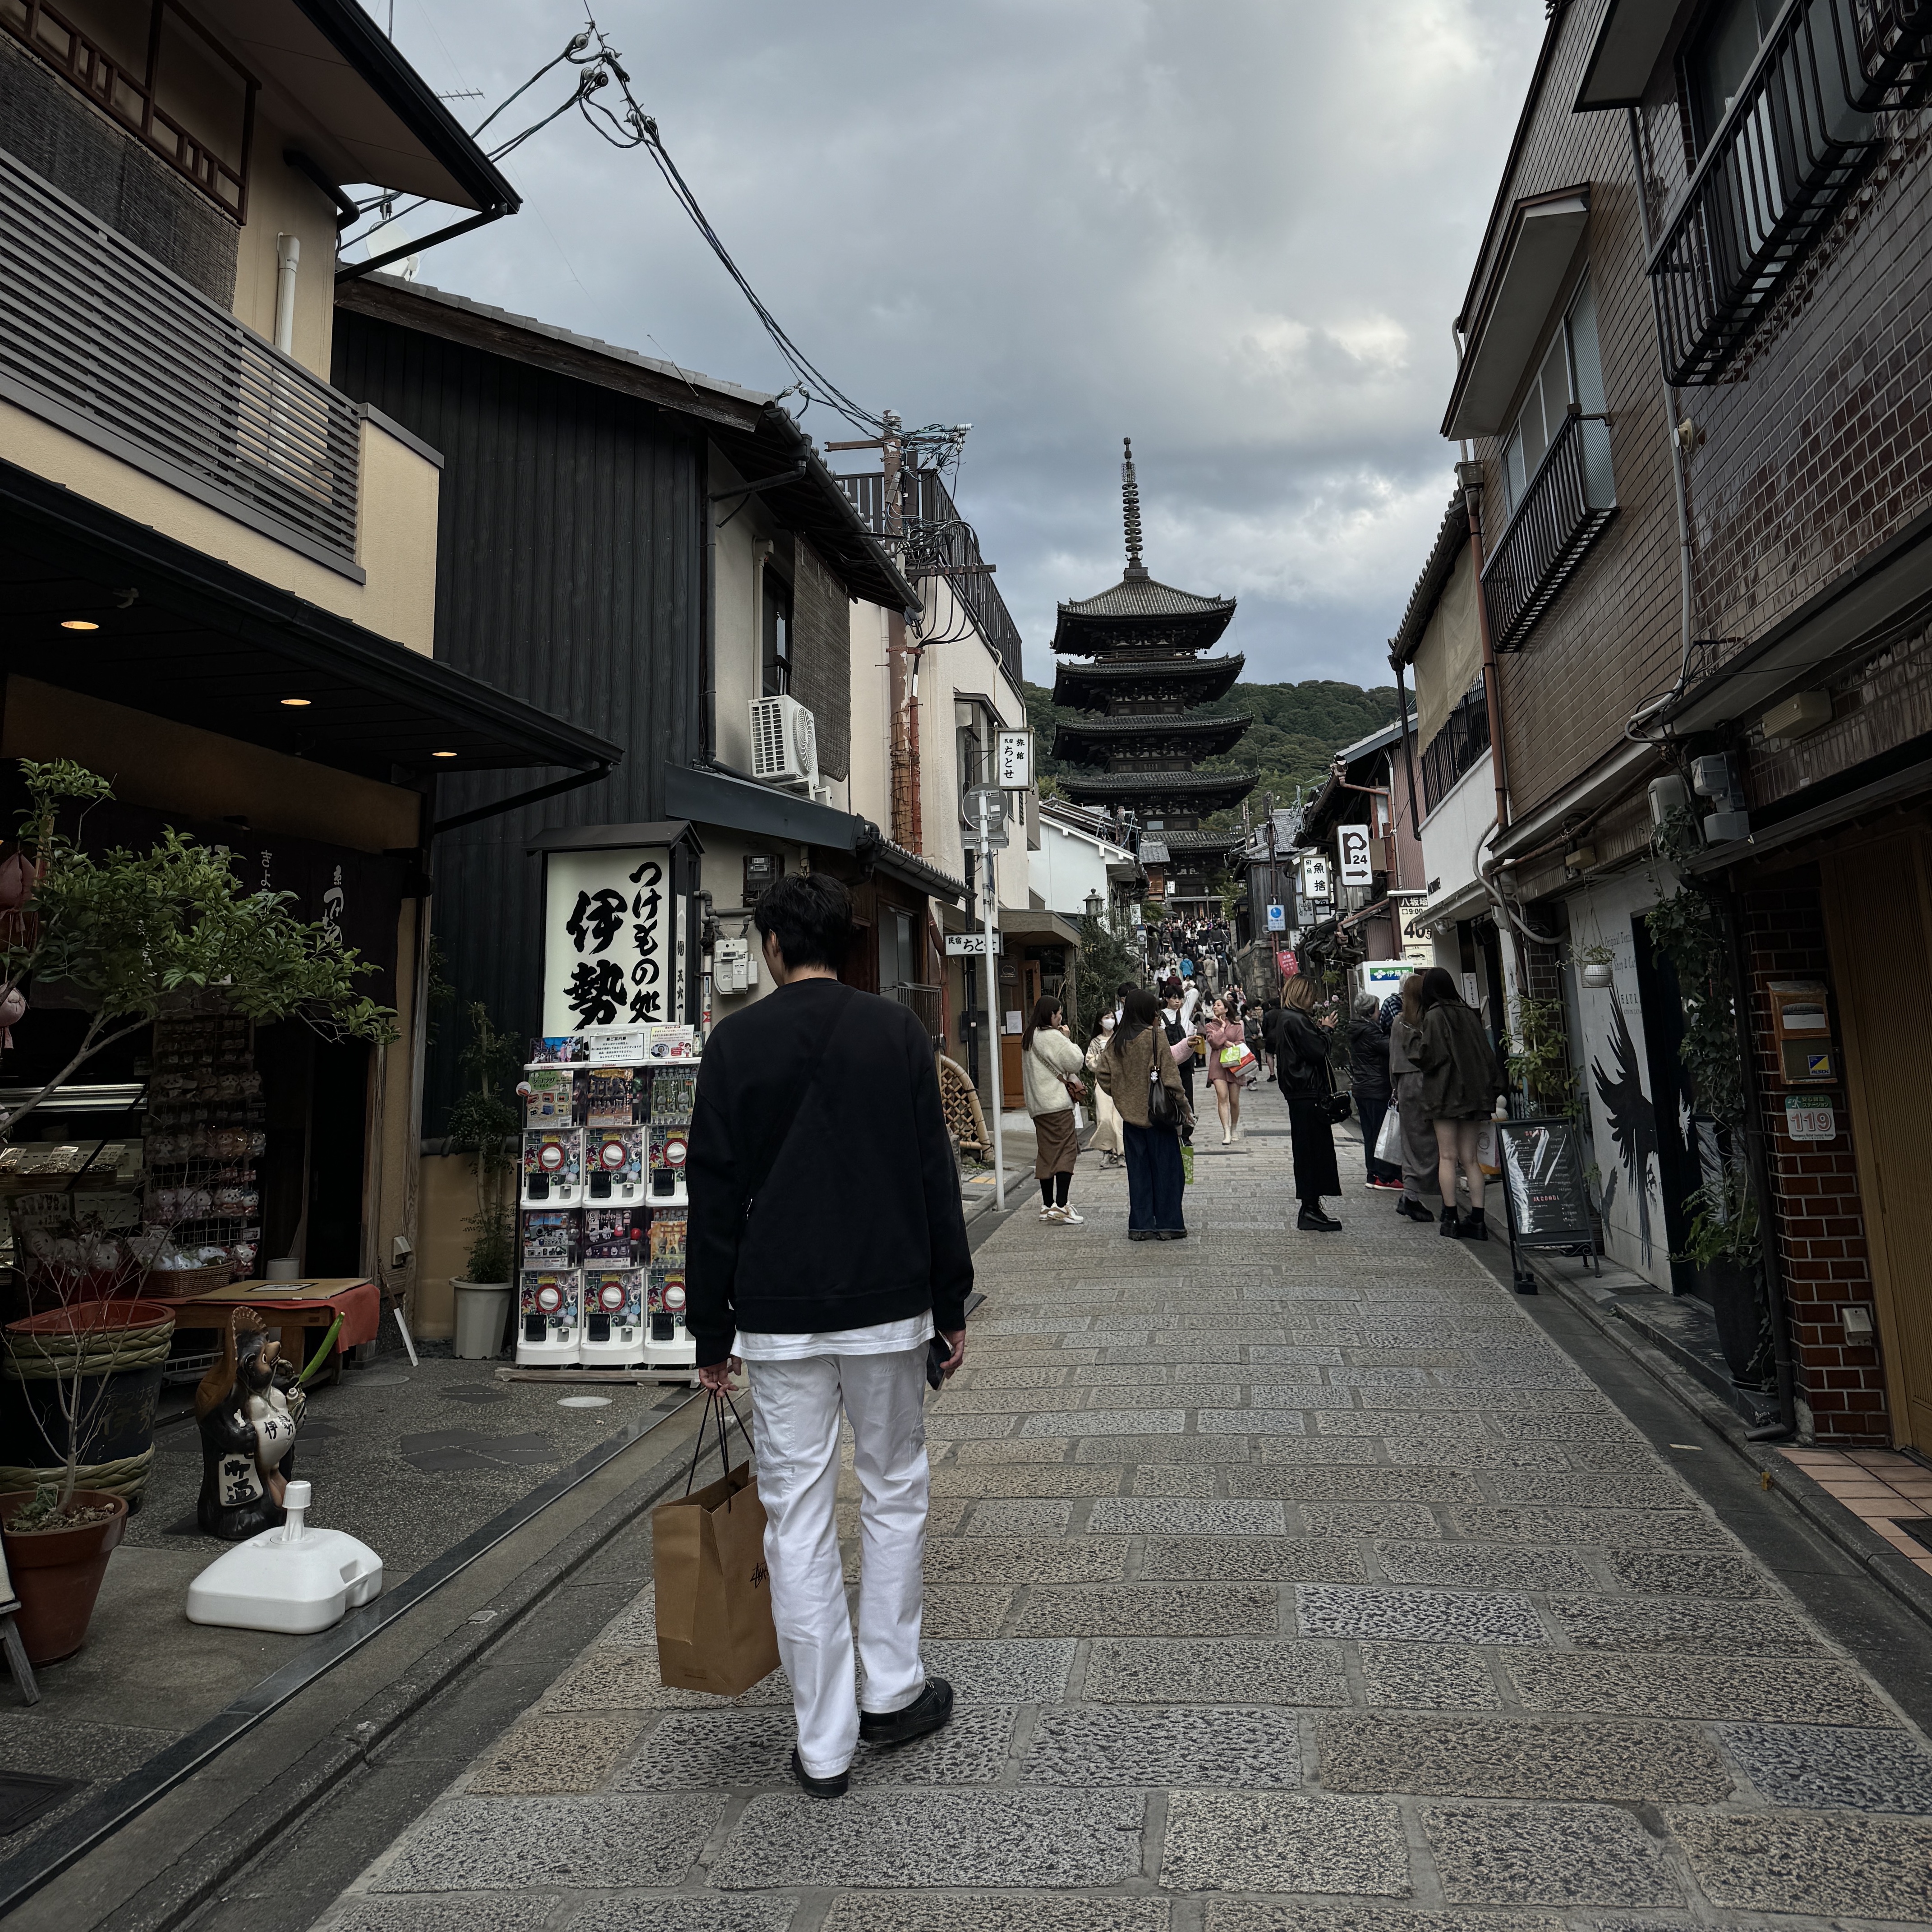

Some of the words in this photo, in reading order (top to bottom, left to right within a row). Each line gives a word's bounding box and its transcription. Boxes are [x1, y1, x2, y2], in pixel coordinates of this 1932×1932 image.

[1004, 746, 1014, 778] ちとせ
[1016, 738, 1025, 759] 旅館
[261, 850, 272, 891] きよ
[1353, 855, 1368, 864] 24
[1314, 863, 1326, 891] 魚捨
[628, 862, 662, 1024] つけもの処
[563, 888, 628, 1060] 伊勢
[1791, 1111, 1831, 1132] 119
[264, 1415, 294, 1440] 伊勢
